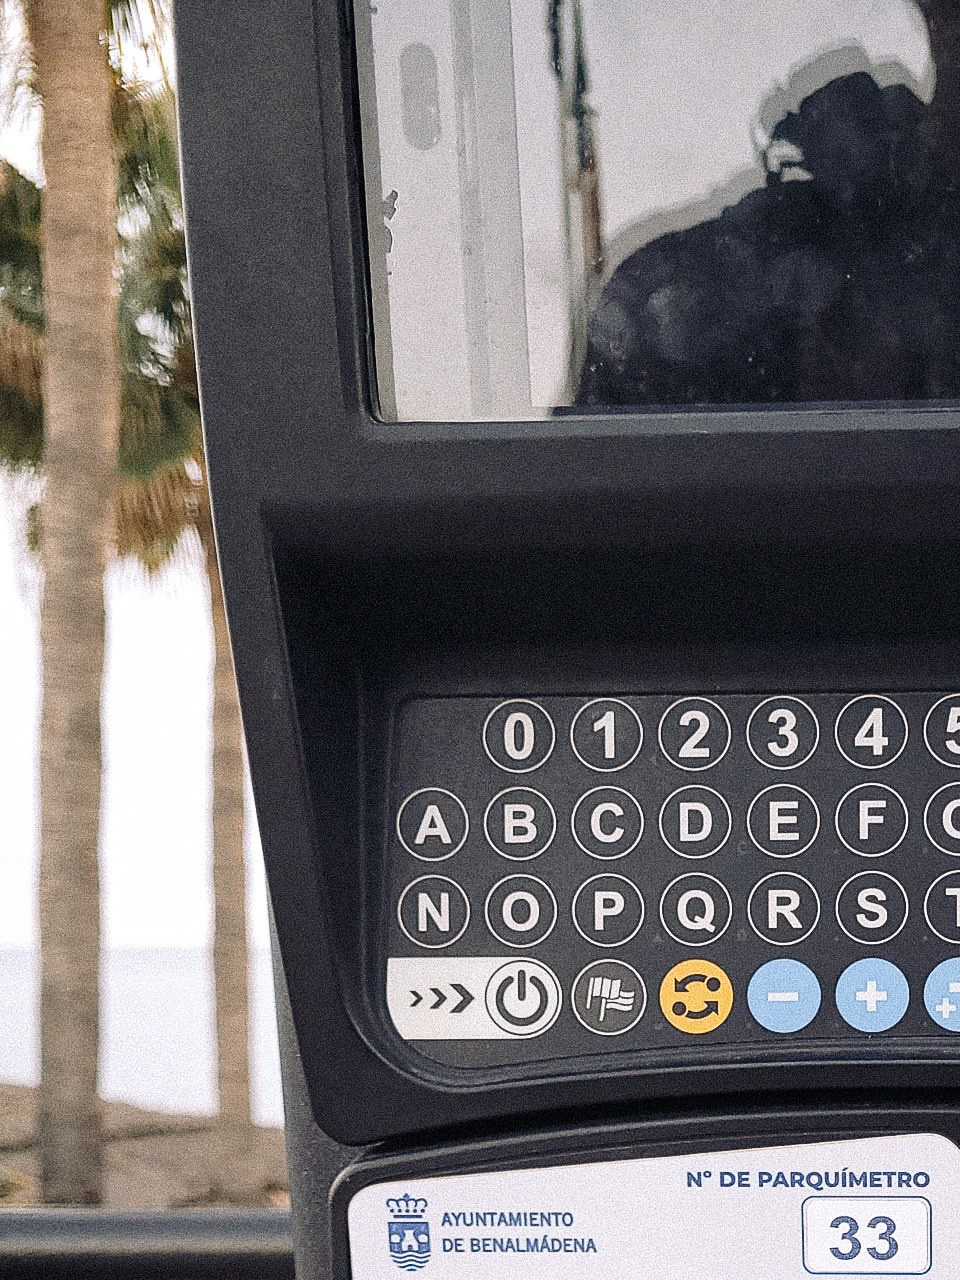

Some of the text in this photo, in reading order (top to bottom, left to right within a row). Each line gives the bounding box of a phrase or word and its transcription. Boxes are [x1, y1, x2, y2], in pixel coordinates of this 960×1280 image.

[504, 713, 534, 759] 0
[594, 711, 614, 758] 1
[679, 711, 709, 757] 2
[768, 709, 798, 756] 3
[855, 708, 888, 755] 4
[414, 806, 452, 844] A
[505, 804, 536, 843] B
[591, 803, 624, 842] C
[680, 803, 712, 841] D
[770, 801, 799, 840] E
[860, 801, 886, 839] F
[419, 893, 449, 931] N
[503, 892, 539, 931] O
[595, 891, 624, 930] P
[678, 890, 715, 932] Q
[768, 890, 802, 928] R
[857, 888, 887, 928] S
[720, 1172, 750, 1187] DE
[759, 1168, 930, 1191] PARQUÍMETRO
[442, 1212, 573, 1227] AYUNTAMIENTO
[830, 1216, 898, 1260] 33
[443, 1235, 597, 1252] DE BENALMÁDENA
